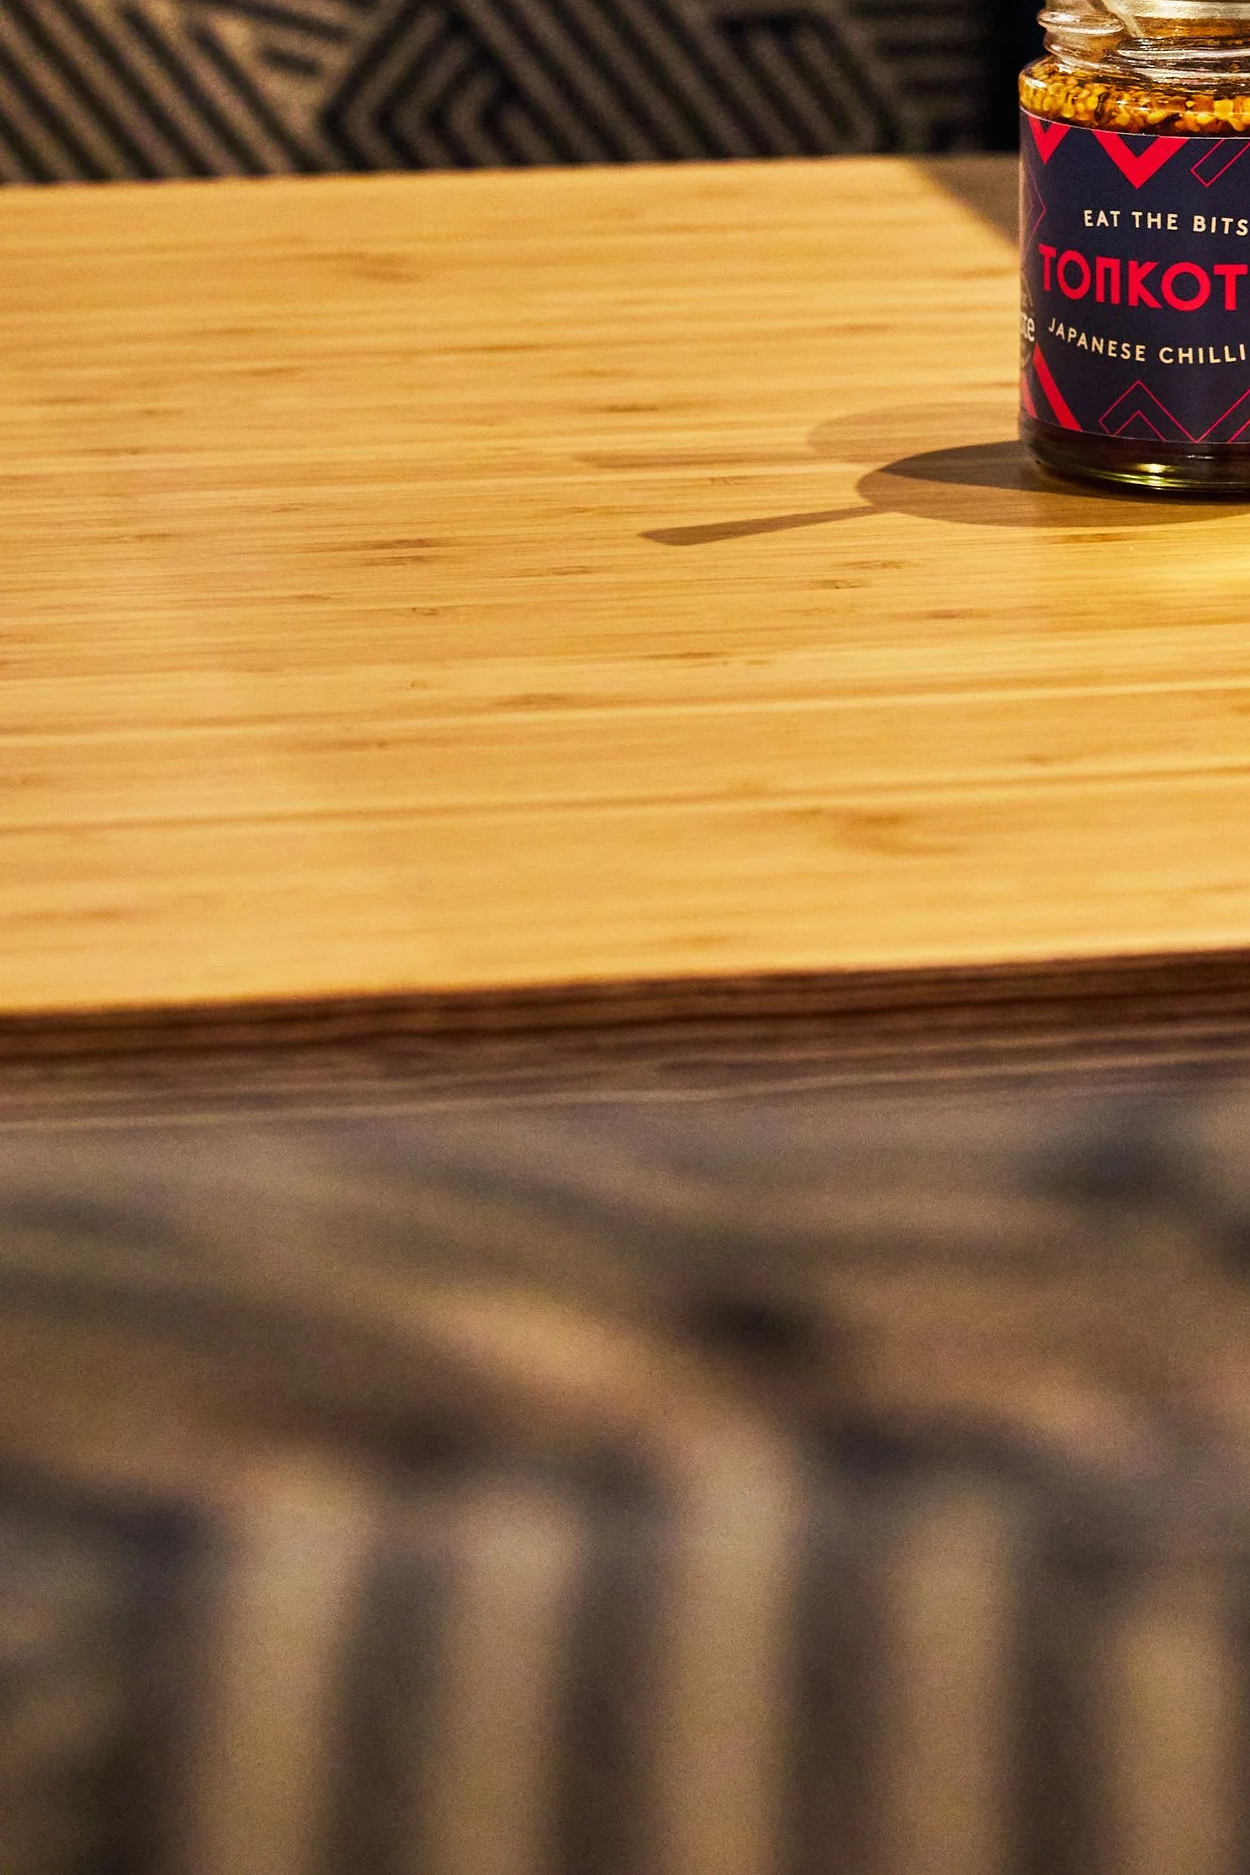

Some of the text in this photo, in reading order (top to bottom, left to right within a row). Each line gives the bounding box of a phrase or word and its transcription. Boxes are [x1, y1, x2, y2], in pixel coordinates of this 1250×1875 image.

[1083, 209, 1249, 237] EAT THE BITS
[1048, 317, 1147, 363] JAPANESE
[1159, 343, 1246, 364] CHILLI
